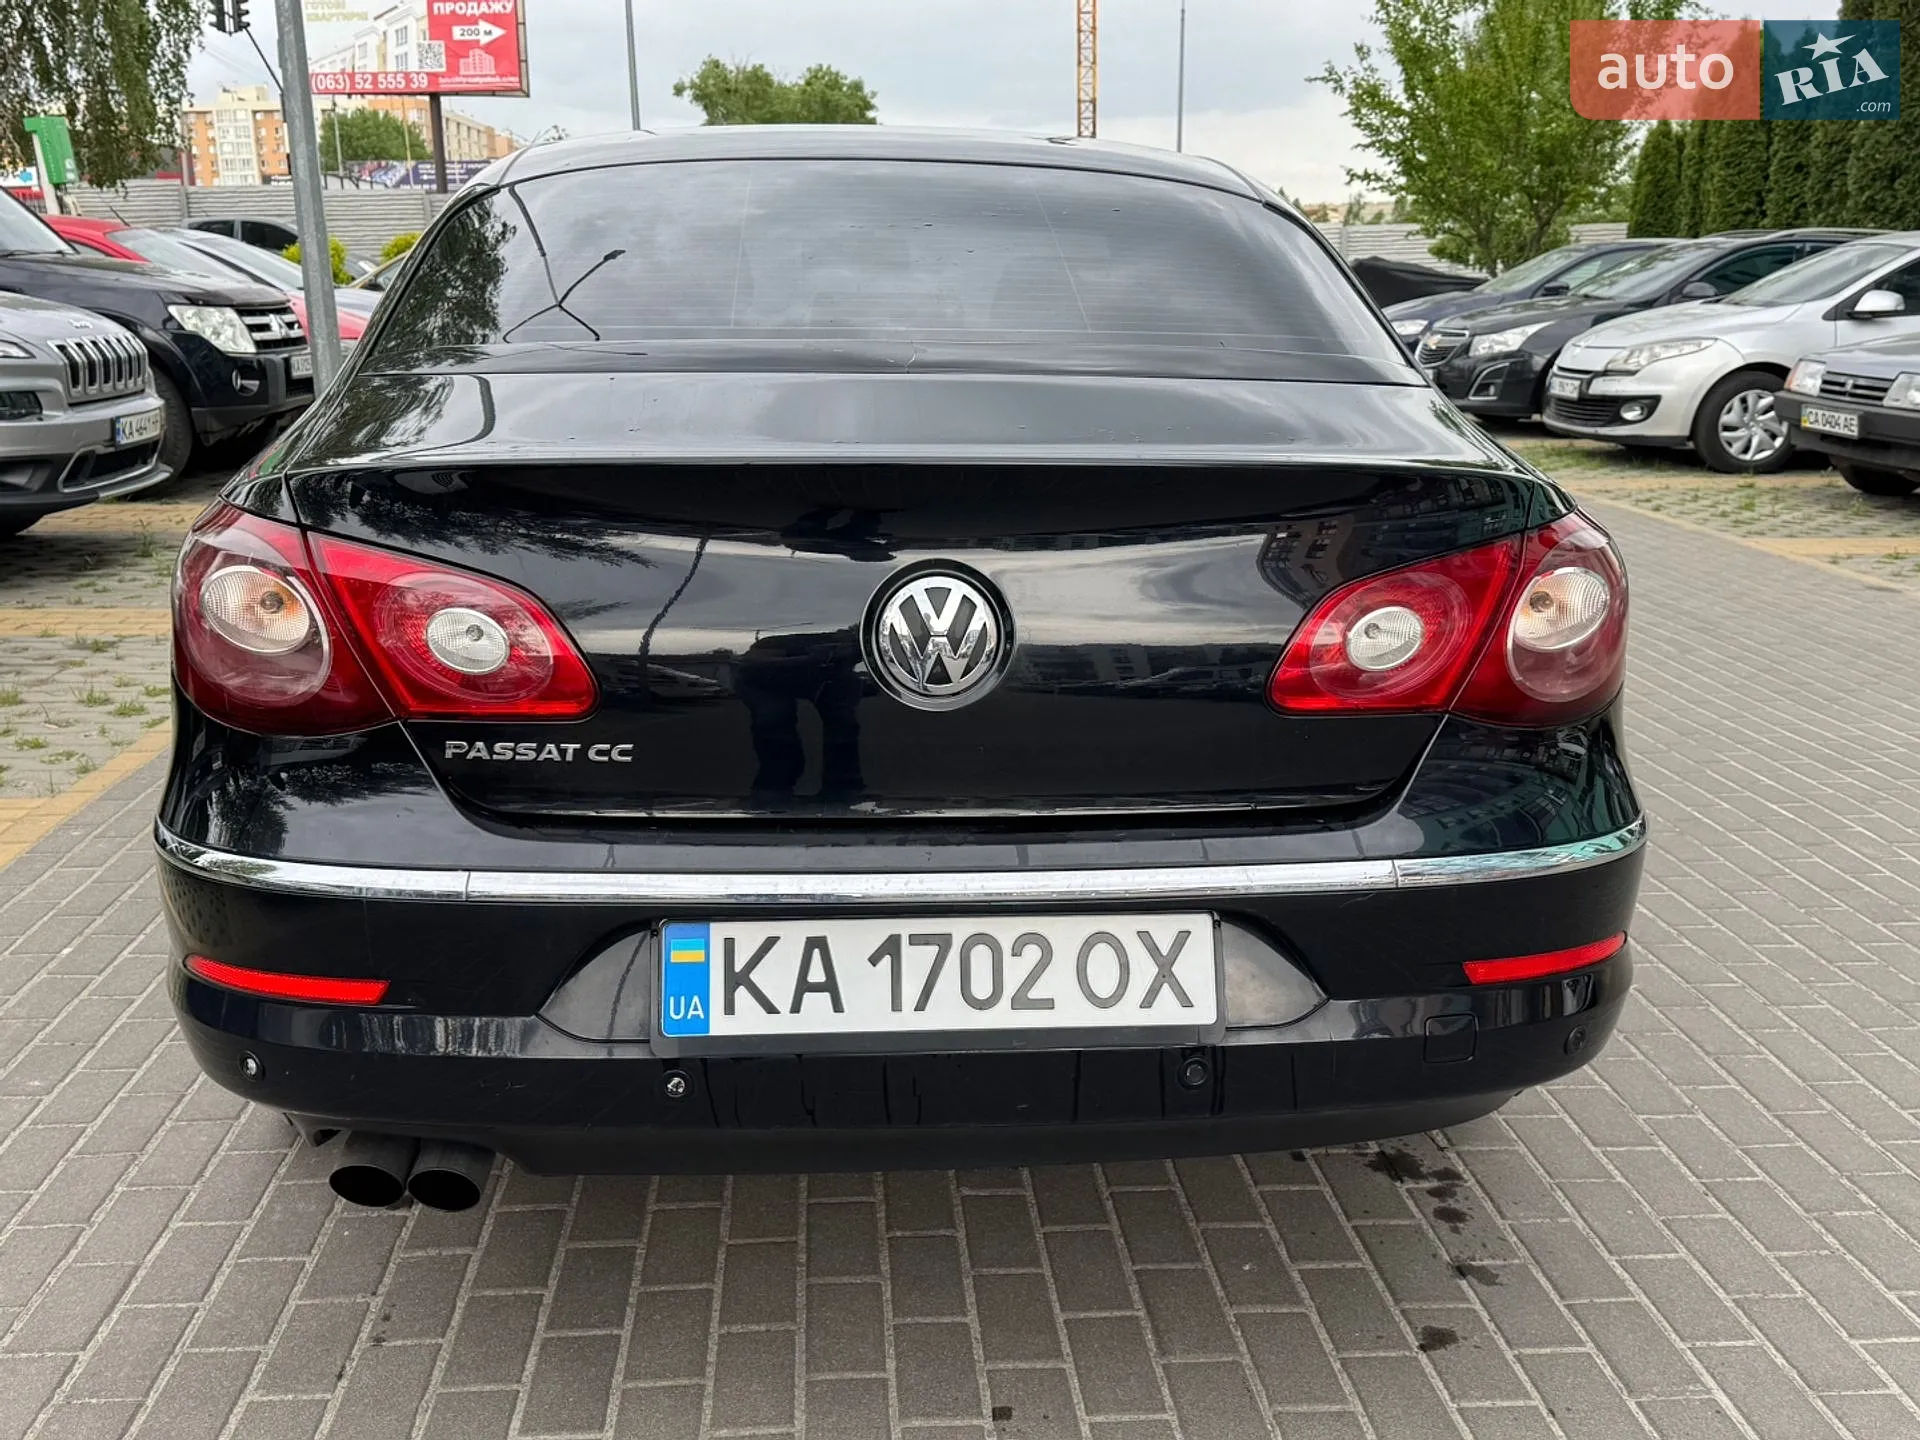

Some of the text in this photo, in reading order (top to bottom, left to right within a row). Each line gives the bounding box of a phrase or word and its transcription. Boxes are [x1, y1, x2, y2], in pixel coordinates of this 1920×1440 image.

[433, 1, 514, 16] ПРОДАЖУ
[459, 28, 480, 37] 200
[311, 74, 350, 92] (063)
[355, 74, 372, 89] 52
[378, 75, 405, 88] 555
[410, 74, 428, 88] 39
[1808, 410, 1820, 426] CA
[1843, 416, 1855, 433] AE
[444, 741, 634, 763] PASSAT CC
[669, 930, 1194, 1019] UA KA 1702 OX
